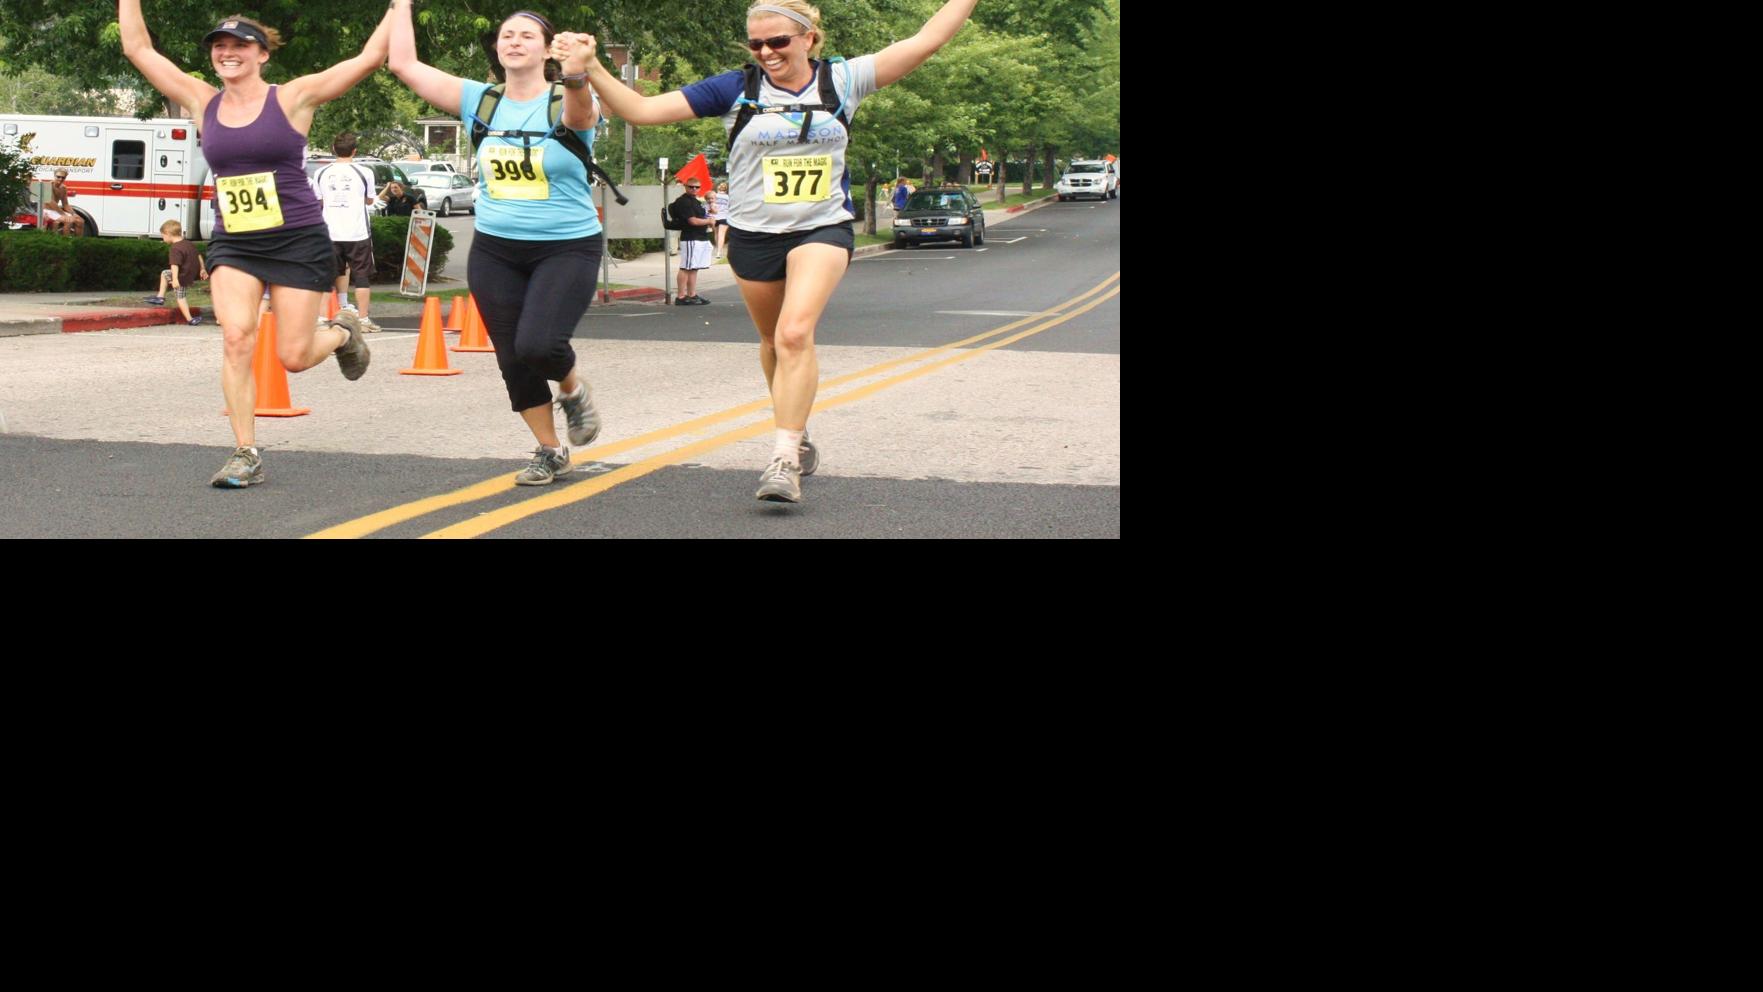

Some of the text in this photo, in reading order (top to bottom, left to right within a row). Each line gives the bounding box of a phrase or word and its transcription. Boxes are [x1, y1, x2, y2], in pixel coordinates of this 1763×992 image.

[759, 127, 841, 139] MADSON
[31, 156, 96, 167] GUARDIAN
[774, 169, 823, 196] 377
[226, 187, 268, 214] 394
